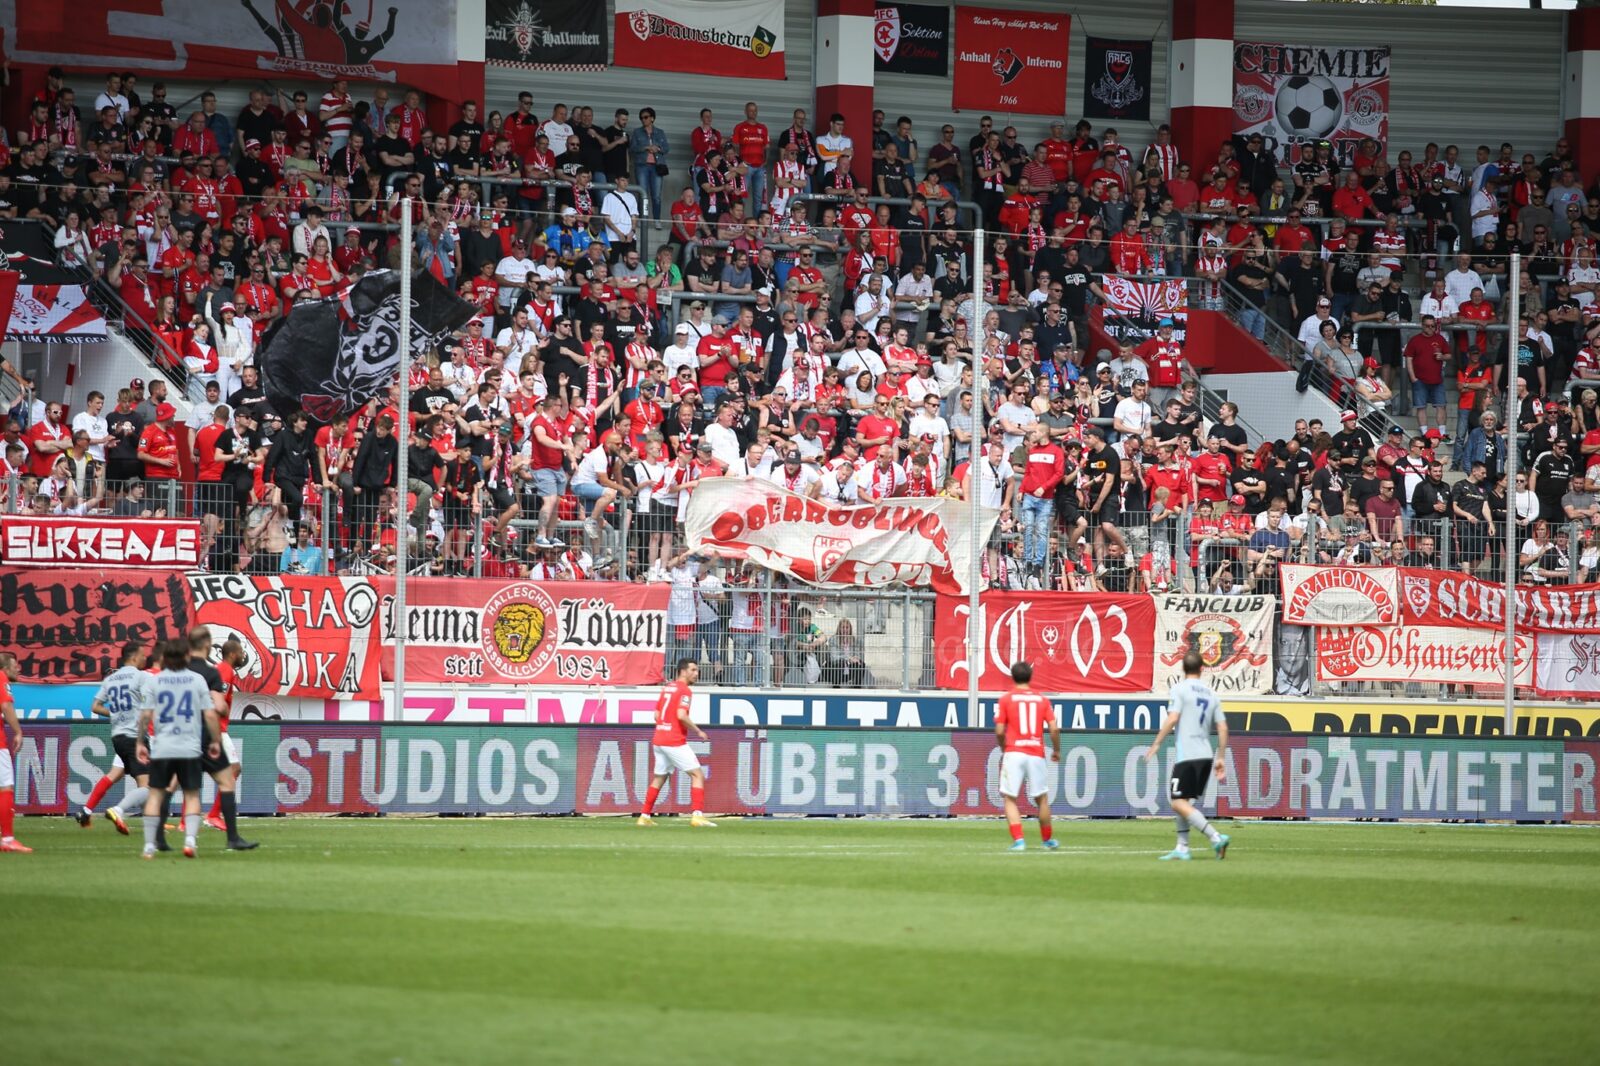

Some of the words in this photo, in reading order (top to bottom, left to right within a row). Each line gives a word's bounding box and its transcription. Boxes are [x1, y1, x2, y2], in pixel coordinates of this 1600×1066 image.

[648, 15, 751, 49] Braunsbedra
[900, 22, 943, 40] Sektion
[973, 16, 992, 26] Unser
[992, 17, 1006, 28] Herz
[1007, 20, 1027, 30] schlägt
[541, 30, 601, 48] Hallunken
[959, 51, 992, 63] Anhalt
[1026, 56, 1063, 69] Inferno
[1233, 43, 1388, 78] CHEMIE
[998, 95, 1019, 105] 1966
[7, 525, 197, 562] SURREALE
[192, 576, 246, 603] HFC
[487, 587, 554, 617] HALLESCHER
[1164, 596, 1265, 613] FANCLUB
[1289, 569, 1393, 623] MARATHONTOR
[255, 582, 379, 632] CHAO
[559, 599, 664, 648] Löwen
[481, 628, 550, 677] FUSSBALLCLUB
[1070, 603, 1134, 679] 03
[268, 646, 362, 693] TIKA
[445, 653, 484, 677] seit
[556, 653, 610, 680] 1984
[107, 685, 132, 714] 35
[158, 690, 194, 723] 24
[661, 693, 671, 721] 7
[1196, 698, 1209, 727] 7
[1018, 702, 1037, 735] 11
[274, 737, 561, 806] STUDIOS
[736, 729, 900, 807] ÜBER
